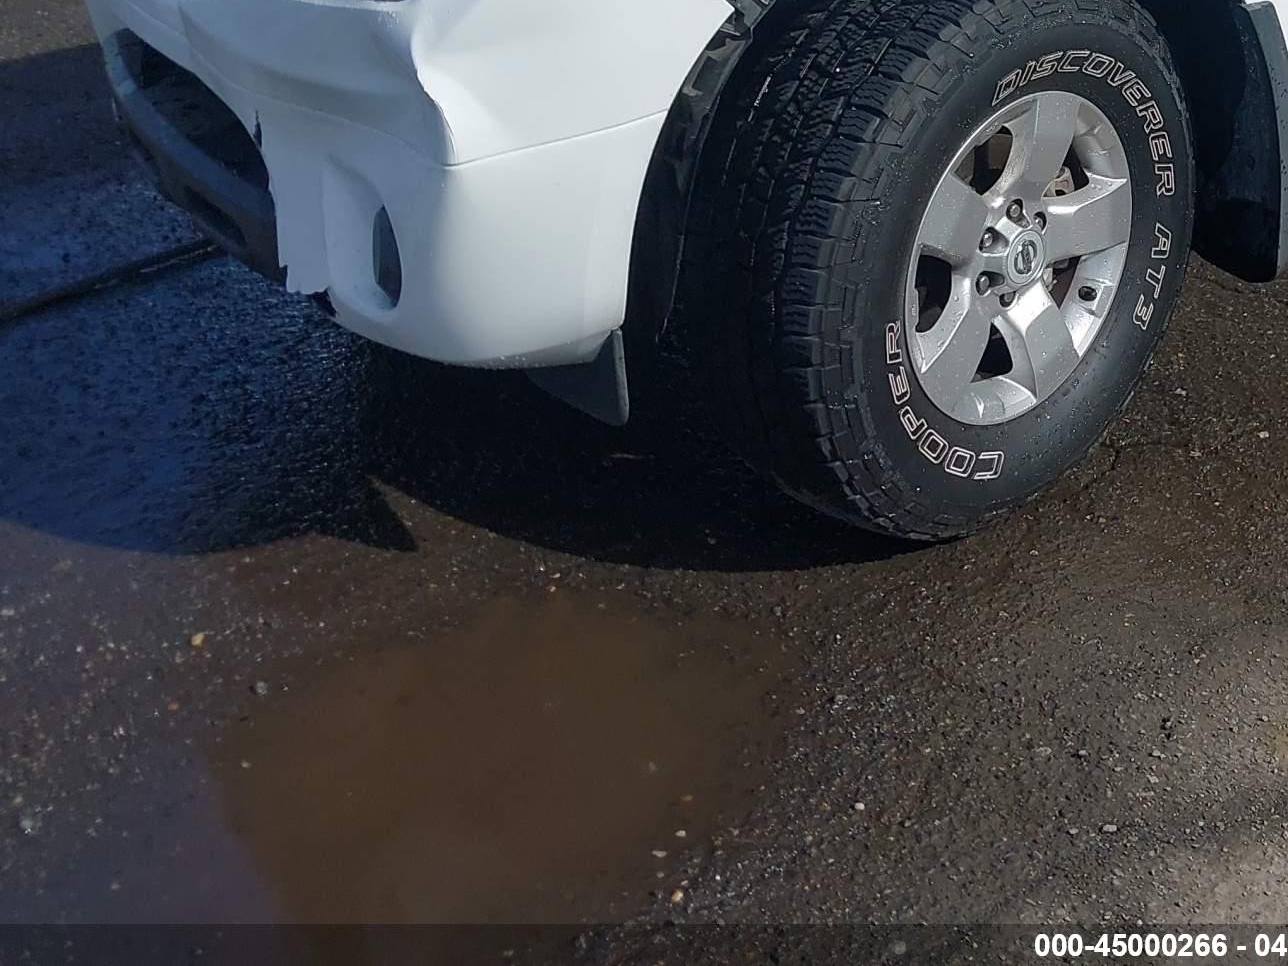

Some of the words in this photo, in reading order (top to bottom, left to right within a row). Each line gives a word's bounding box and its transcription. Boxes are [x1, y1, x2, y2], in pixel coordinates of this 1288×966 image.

[991, 50, 1175, 197] DISCOVERER
[1132, 222, 1173, 331] AT3
[885, 321, 1005, 480] COOPER
